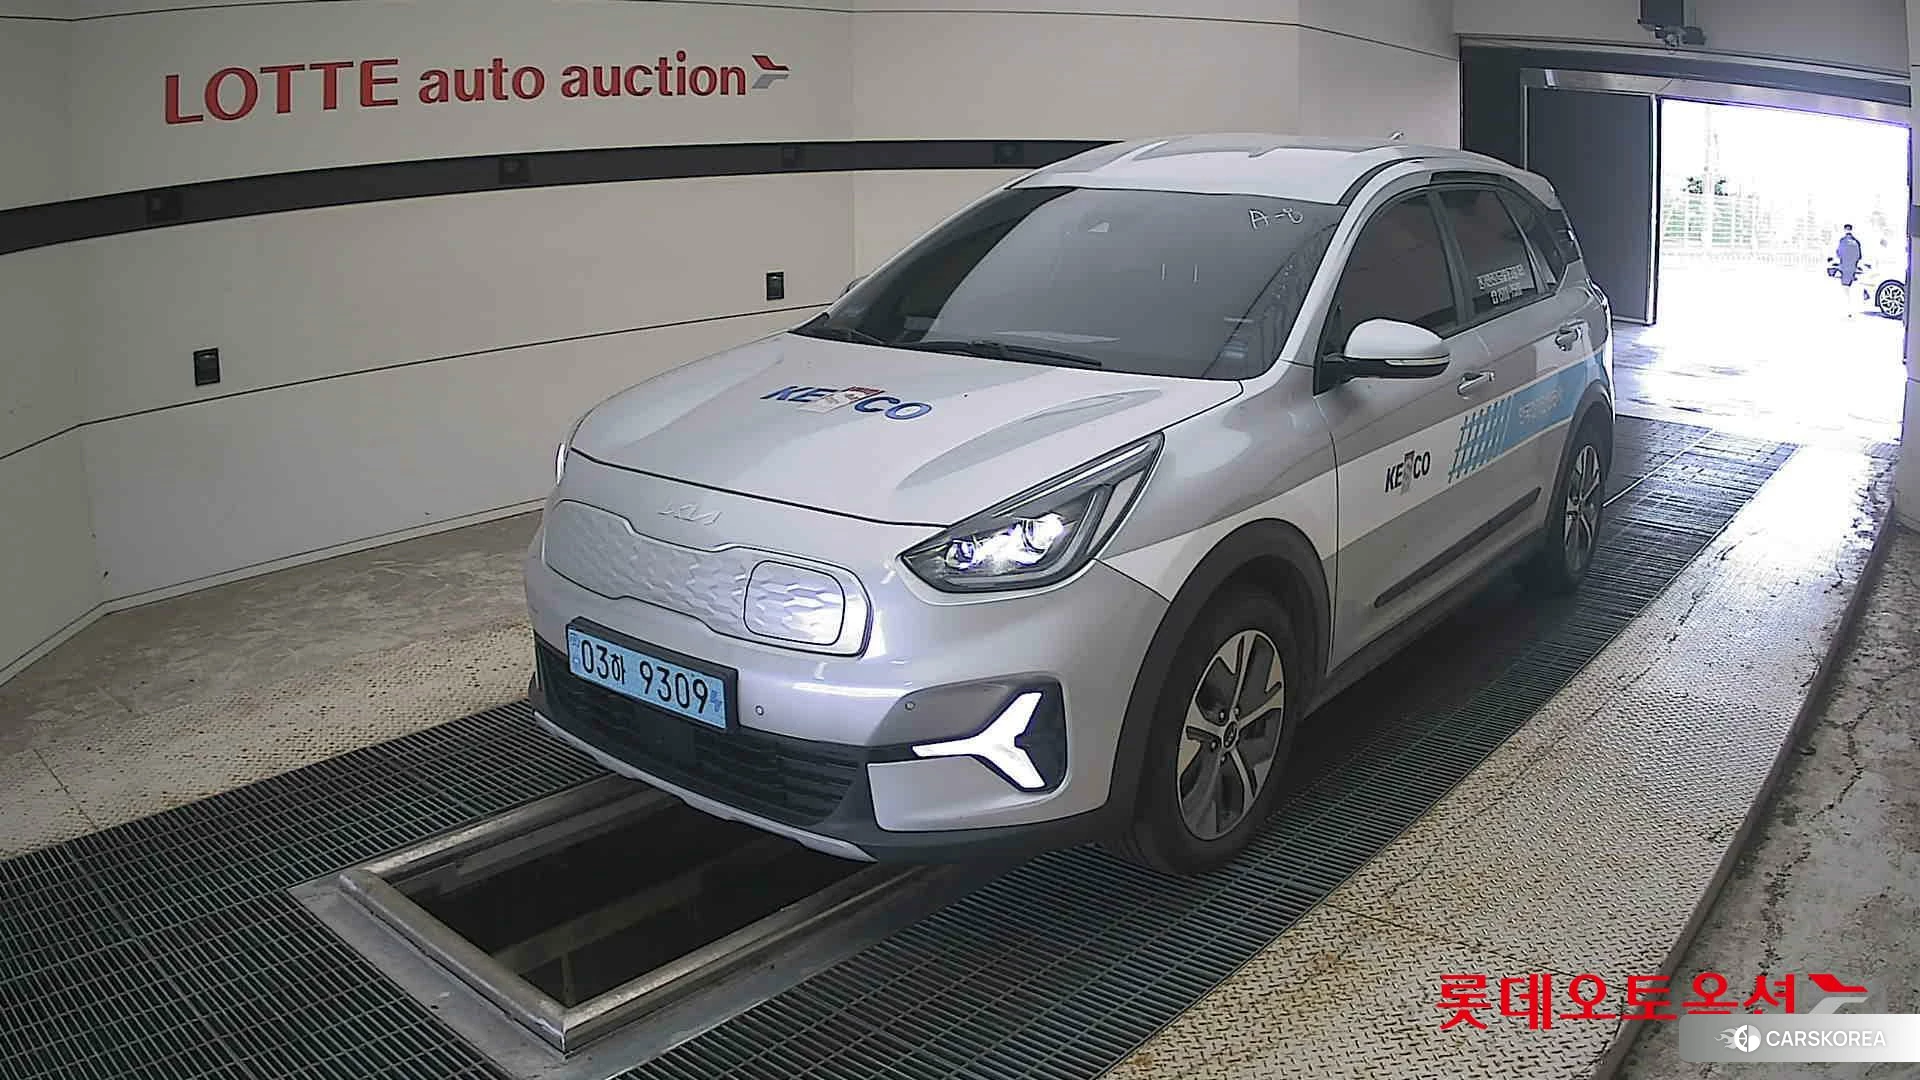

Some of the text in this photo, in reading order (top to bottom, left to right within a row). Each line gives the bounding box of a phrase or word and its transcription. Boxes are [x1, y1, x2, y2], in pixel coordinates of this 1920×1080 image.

[165, 50, 748, 125] LOTTE auto auction
[760, 386, 932, 420] KECO
[1384, 450, 1431, 493] KECO
[581, 639, 709, 714] 03하 9309
